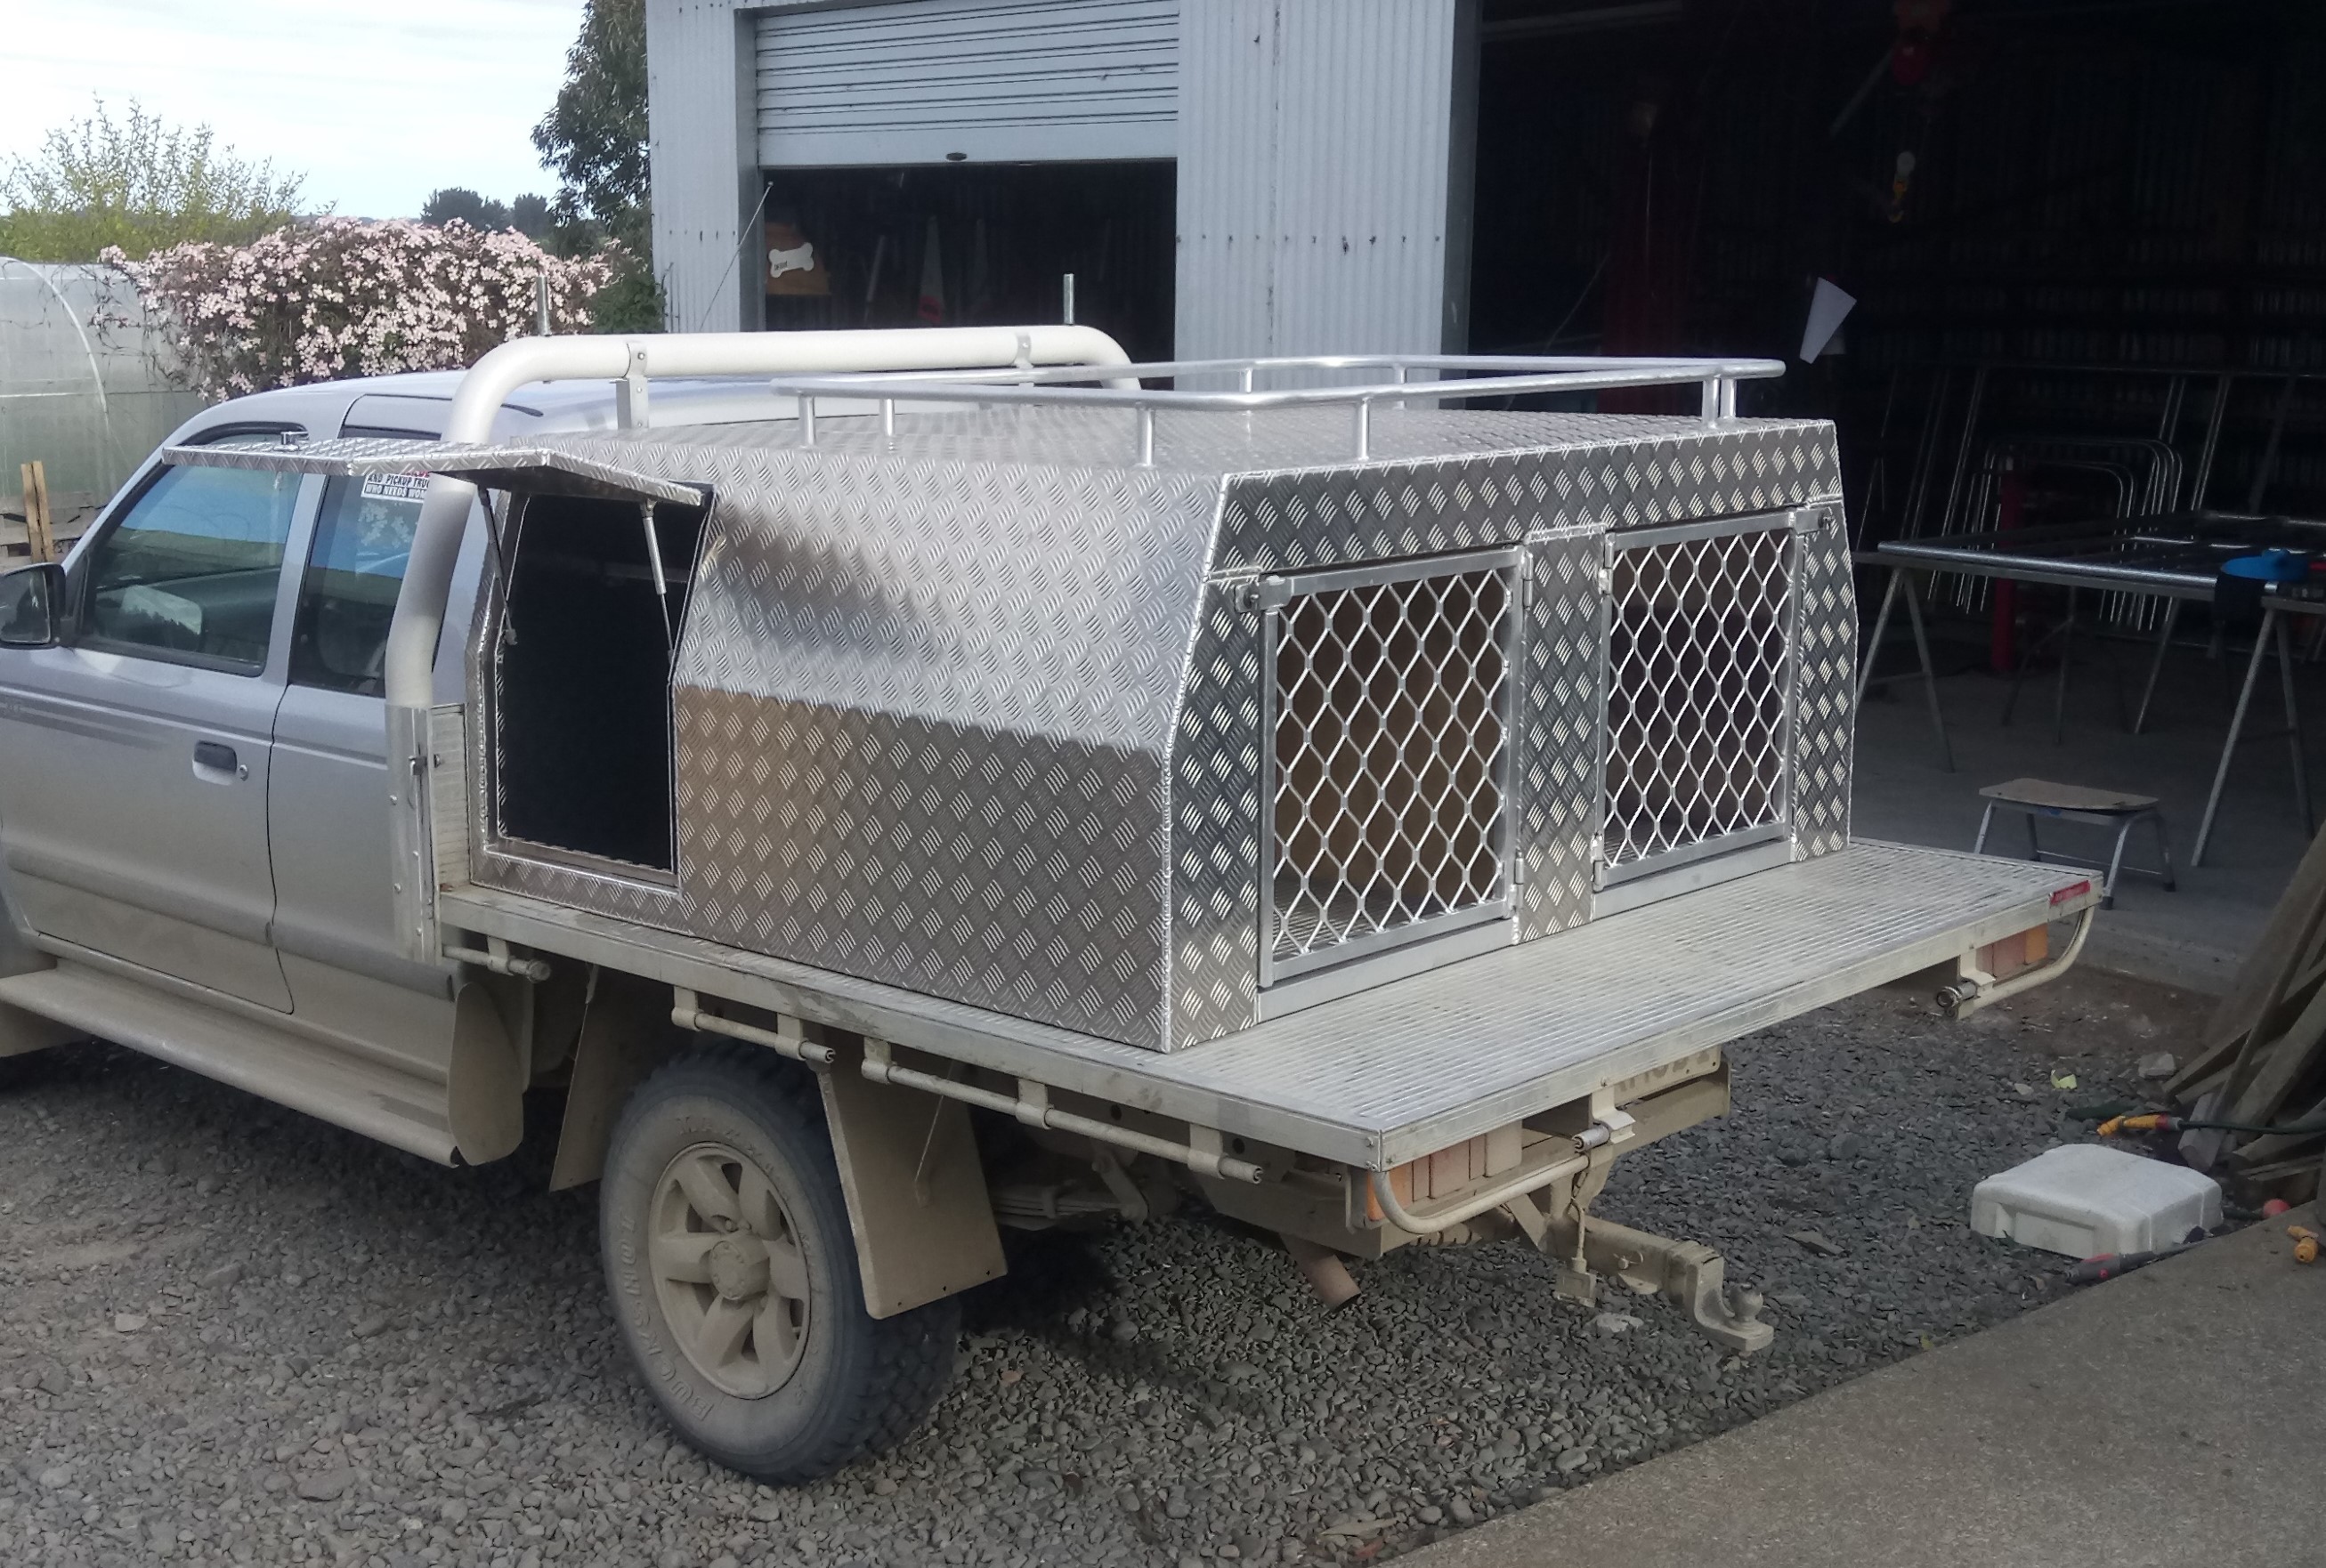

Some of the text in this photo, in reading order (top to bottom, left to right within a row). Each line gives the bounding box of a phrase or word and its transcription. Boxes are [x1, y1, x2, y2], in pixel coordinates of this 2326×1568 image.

[386, 474, 412, 486] PICKUP
[366, 484, 382, 494] WHO
[383, 486, 408, 497] NEEDS
[619, 1214, 714, 1421] BUCKSHOT
